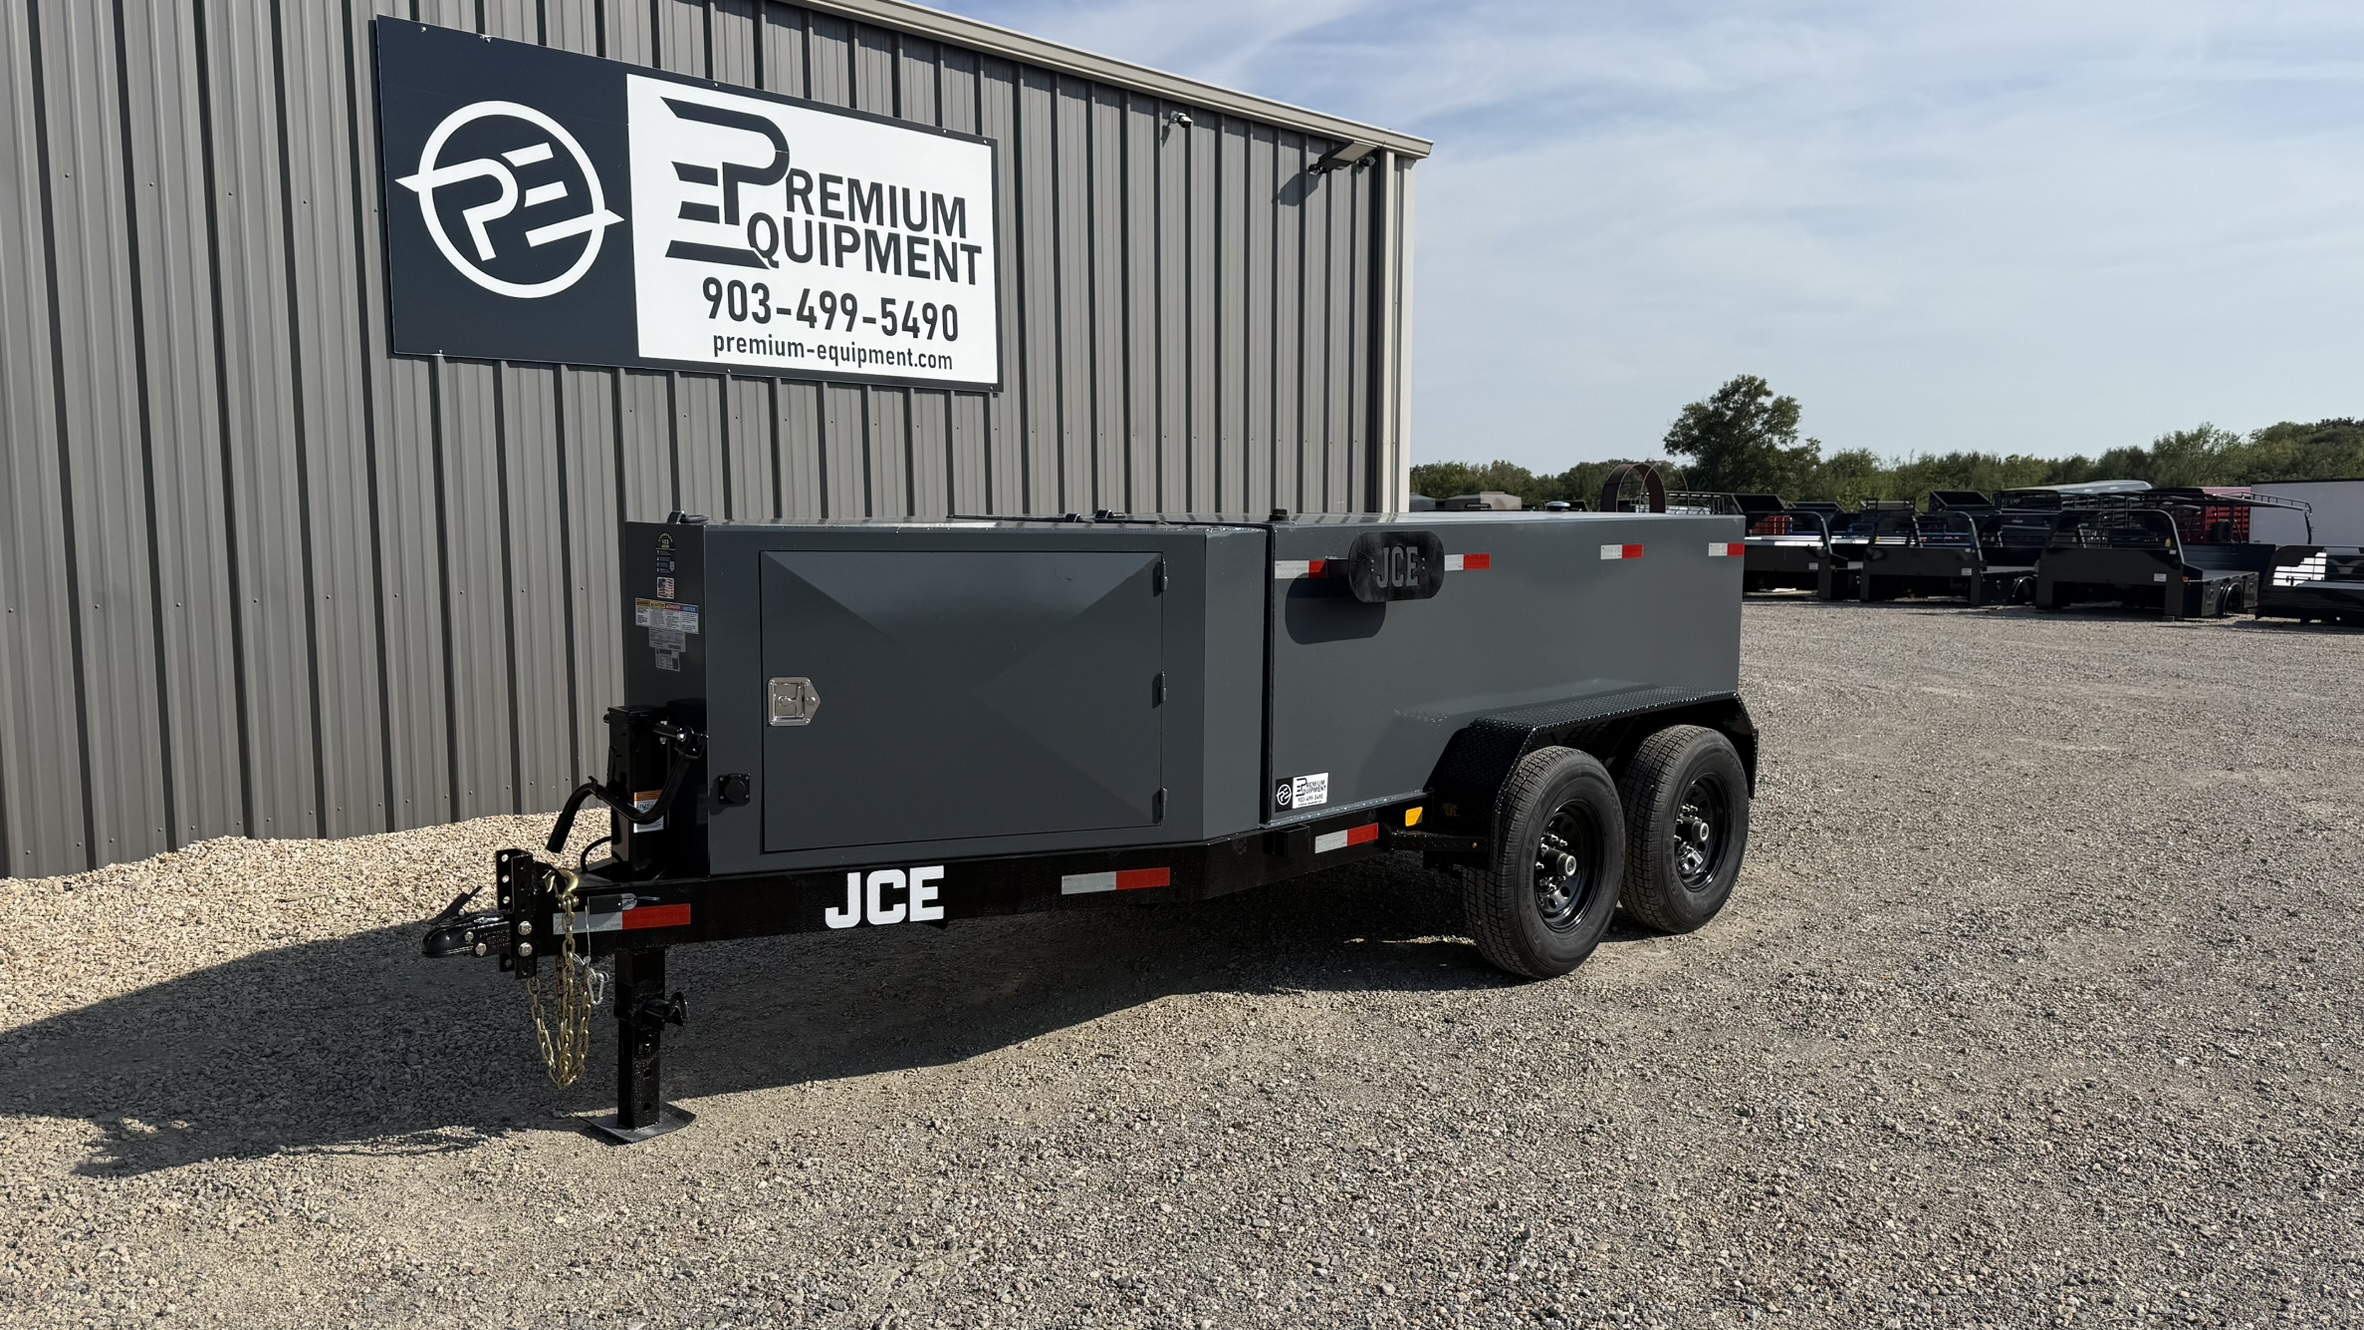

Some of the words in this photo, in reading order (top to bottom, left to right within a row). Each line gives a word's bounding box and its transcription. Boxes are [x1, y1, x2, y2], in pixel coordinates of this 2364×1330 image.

[660, 96, 968, 239] PREMIUM
[665, 161, 983, 286] EQUIPMENT
[702, 276, 960, 342] 903-499-5490
[713, 331, 953, 371] premium-equipment.com
[1376, 544, 1420, 588] JCE
[825, 865, 944, 930] JCE
